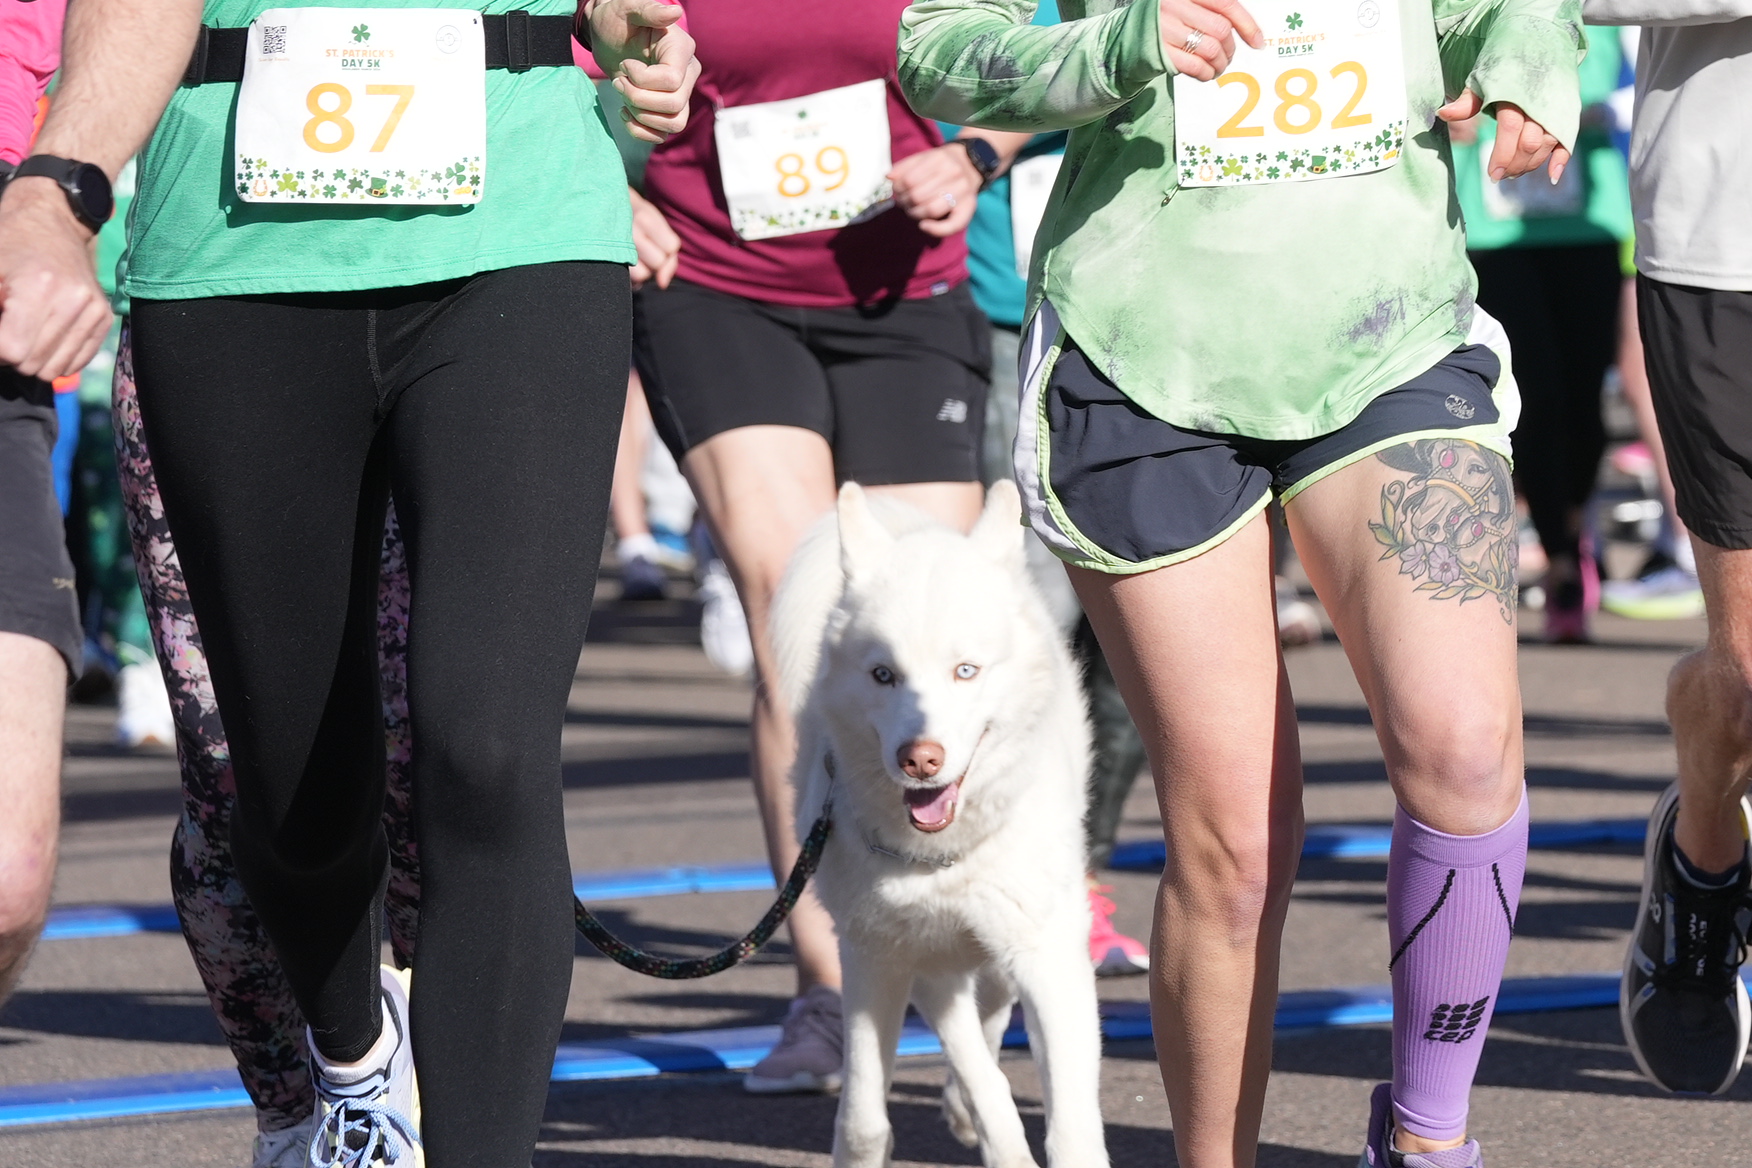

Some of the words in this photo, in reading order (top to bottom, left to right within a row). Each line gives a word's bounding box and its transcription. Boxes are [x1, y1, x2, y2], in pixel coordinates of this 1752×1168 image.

[325, 49, 339, 58] ST.
[342, 49, 395, 58] PATRICK'S
[1278, 45, 1298, 55] DAY
[1302, 44, 1314, 53] 5K
[341, 59, 364, 68] DAY
[367, 59, 381, 68] 5K
[1216, 60, 1373, 139] 282
[302, 82, 415, 154] 87
[775, 145, 850, 198] 89
[1423, 1028, 1476, 1044] cep
